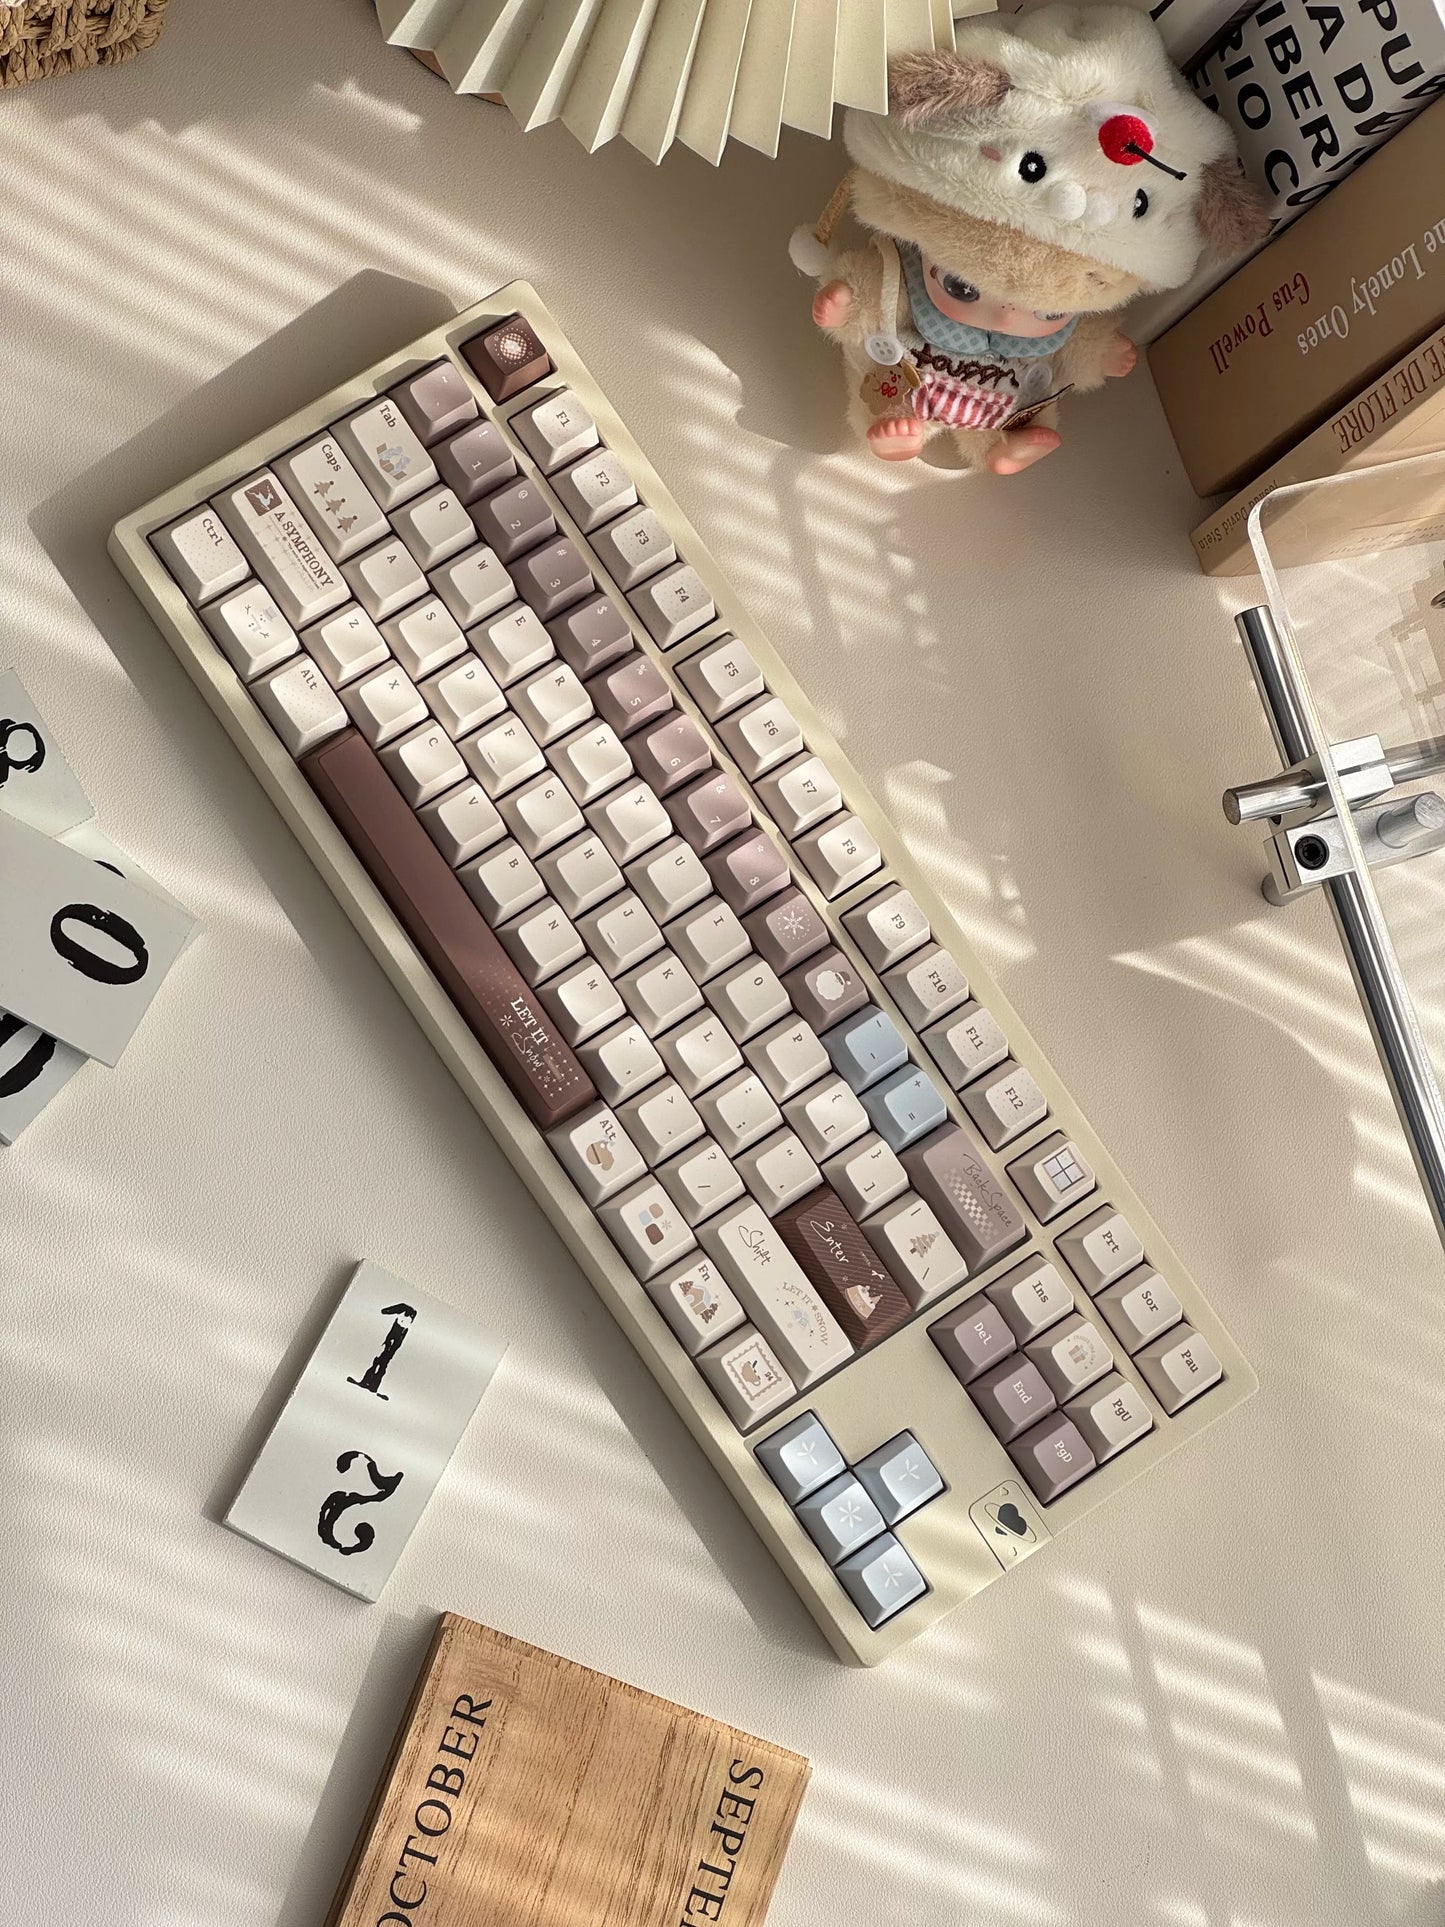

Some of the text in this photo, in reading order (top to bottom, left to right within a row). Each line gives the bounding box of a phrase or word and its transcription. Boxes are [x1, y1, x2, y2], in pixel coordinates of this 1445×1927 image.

[1304, 0, 1346, 54] A
[1255, 1, 1381, 172] IBERI
[1350, 244, 1426, 316] Lonely
[1208, 272, 1311, 375] Gus Powell
[1297, 304, 1350, 355] Ones
[1393, 358, 1428, 405] DE
[380, 405, 396, 427] Tab
[556, 411, 570, 427] F1
[1332, 381, 1398, 454] FLORE
[322, 444, 341, 471] Caps
[472, 461, 481, 470] 1
[596, 471, 610, 487] F2
[519, 490, 528, 499] @
[439, 501, 448, 511] Q
[511, 520, 521, 529] 2
[1222, 508, 1249, 535] David
[203, 519, 223, 546] Ctrl
[635, 529, 649, 545] F3
[1198, 527, 1223, 550] Stein
[274, 510, 284, 523] A
[282, 520, 334, 587] SYMPHONY
[478, 560, 488, 570] W
[675, 587, 689, 603] F4
[349, 619, 359, 628] Z
[515, 616, 526, 626] E
[465, 670, 475, 679] D
[637, 665, 647, 675] %
[724, 661, 739, 677] F5
[301, 670, 317, 690] Alt
[389, 680, 399, 690] X
[555, 676, 565, 686] R
[631, 697, 641, 706] 5
[763, 720, 778, 736] F6
[429, 737, 438, 747] C
[596, 737, 606, 746] T
[545, 790, 554, 799] G
[716, 784, 725, 794] &
[802, 780, 817, 793] F7
[469, 796, 478, 805] V
[634, 795, 645, 805] Y
[584, 849, 594, 859] H
[842, 839, 856, 855] F8
[509, 858, 518, 868] B
[675, 856, 685, 866] U
[548, 920, 559, 930] N
[714, 916, 724, 926] I
[891, 914, 905, 929] F9
[50, 903, 149, 985] 0
[663, 968, 673, 979] K
[754, 977, 763, 986] O
[587, 979, 598, 990] M
[928, 971, 946, 993] F10
[510, 996, 549, 1045] LET IT
[704, 1031, 713, 1042] L
[793, 1033, 802, 1042] P
[966, 1026, 983, 1050] F11
[511, 1032, 544, 1068] Snow
[832, 1094, 842, 1103] {
[1005, 1087, 1023, 1109] F12
[599, 1119, 617, 1141] Alt
[824, 1125, 835, 1135] [
[871, 1149, 881, 1159] }
[864, 1182, 875, 1192] ]
[737, 1225, 772, 1266] Shift
[810, 1220, 849, 1264] Enter
[1102, 1231, 1119, 1253] Prt
[698, 1264, 710, 1282] Fn
[1032, 1281, 1048, 1303] Ins
[783, 1282, 828, 1346] LET IT SNOW
[974, 1322, 991, 1344] Del
[347, 1303, 417, 1401] 1
[1181, 1350, 1198, 1373] Pau
[1013, 1381, 1032, 1403] End
[1112, 1399, 1132, 1421] PgU
[1054, 1440, 1072, 1462] PgD
[318, 1451, 404, 1556] 2
[680, 1758, 765, 1927] SEPTE
